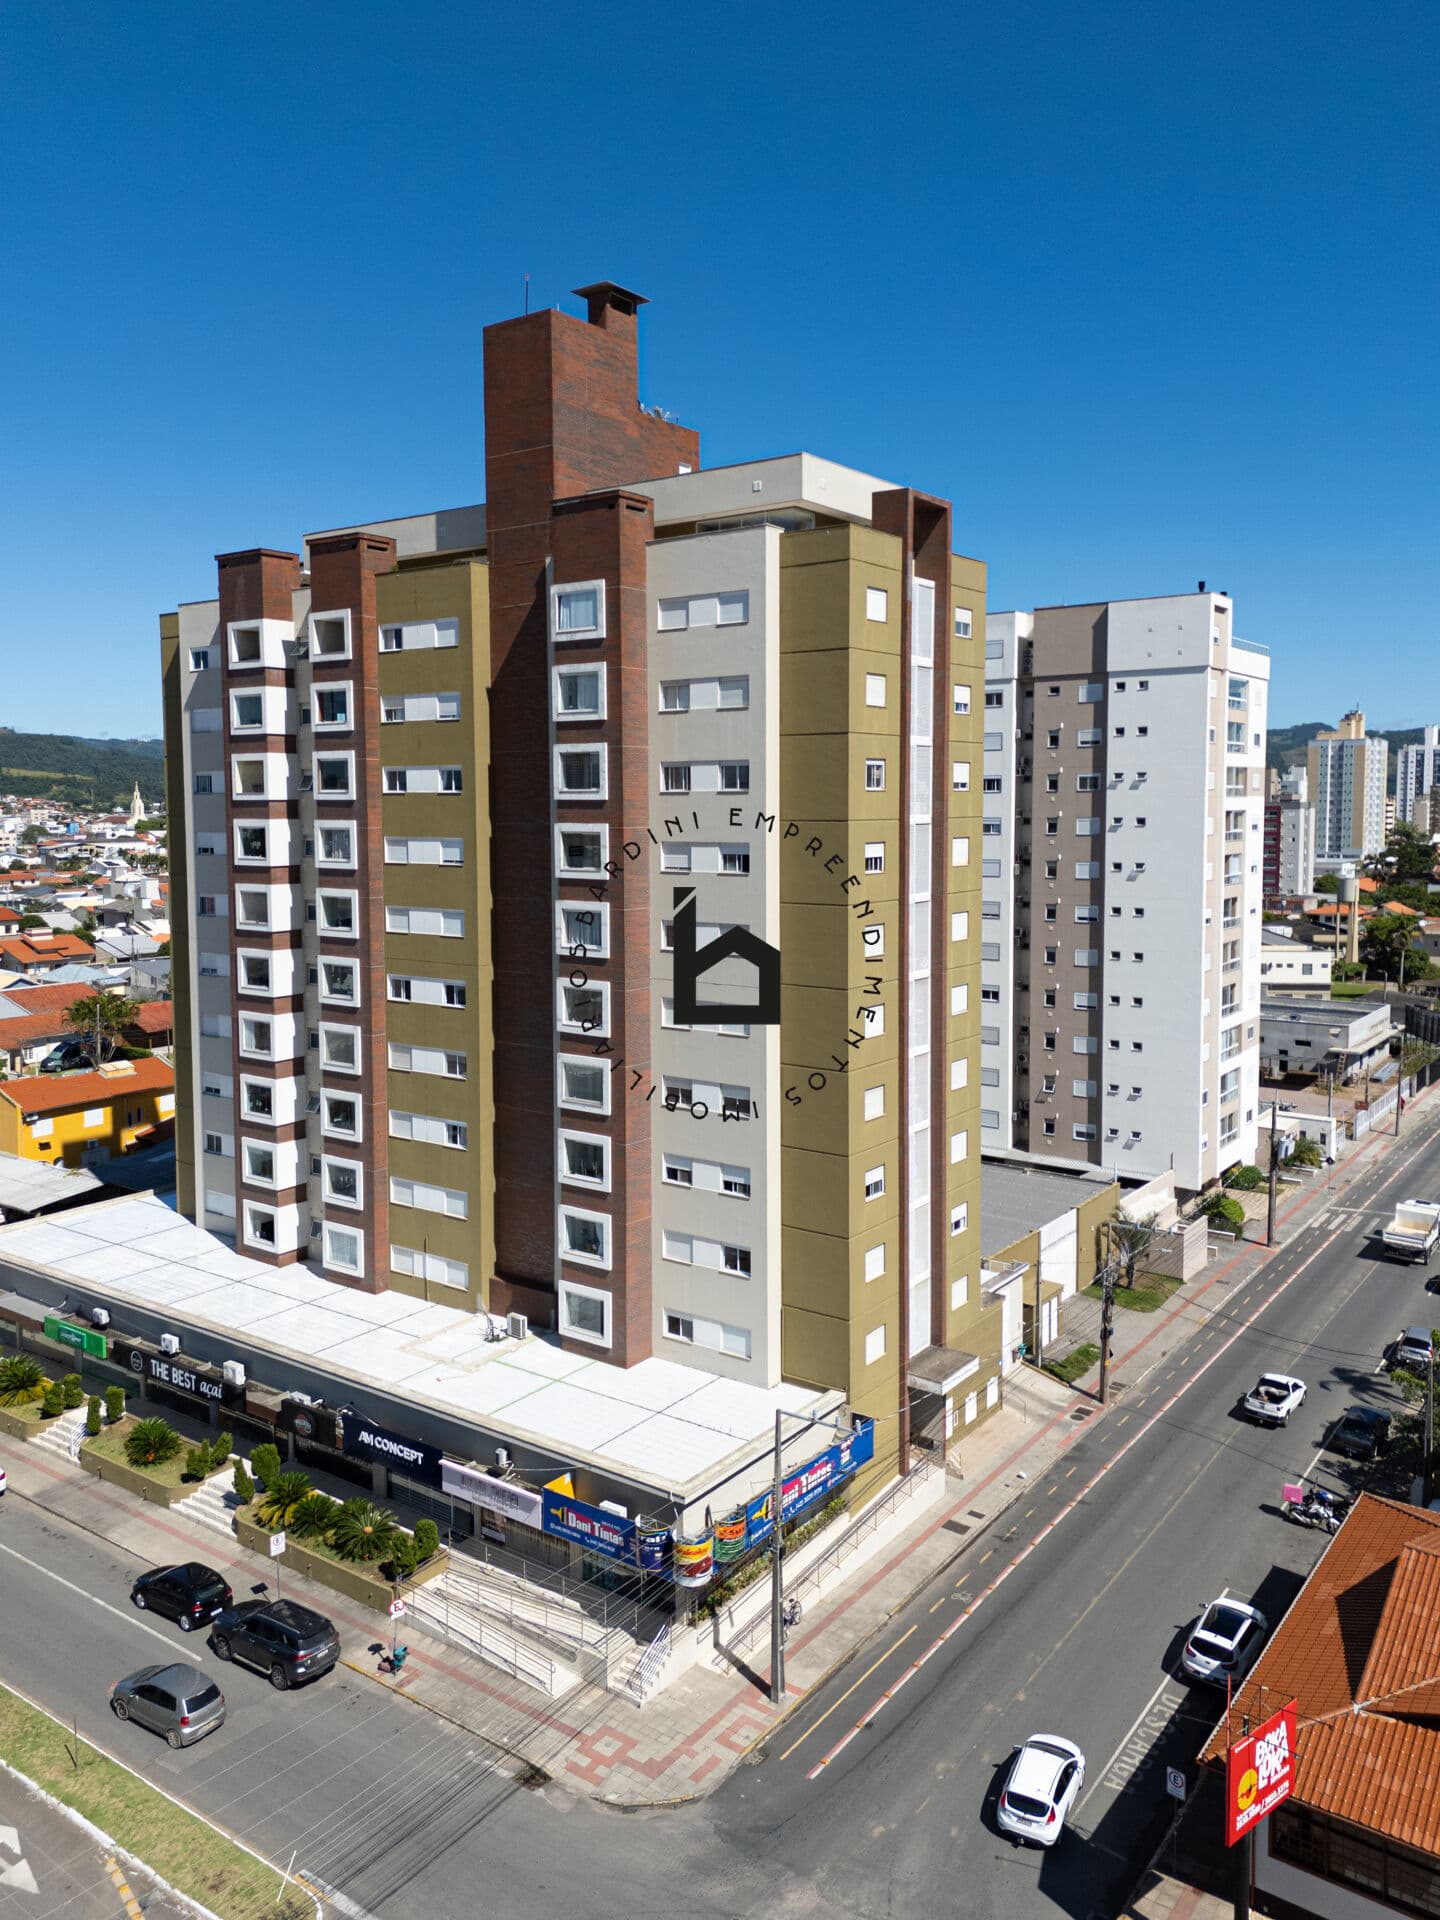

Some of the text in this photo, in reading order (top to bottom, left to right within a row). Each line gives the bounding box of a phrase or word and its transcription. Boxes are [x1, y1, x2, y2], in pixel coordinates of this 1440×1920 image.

[150, 1359, 169, 1381] THE
[172, 1367, 196, 1392] BEST
[358, 1431, 374, 1446] AM
[375, 1437, 424, 1465] CONCEPT
[800, 1463, 832, 1493] Tintas
[568, 1511, 592, 1534] Dani
[593, 1521, 625, 1547] Tintas
[1255, 1720, 1288, 1767] BOKA
[1257, 1738, 1290, 1790] LOKA
